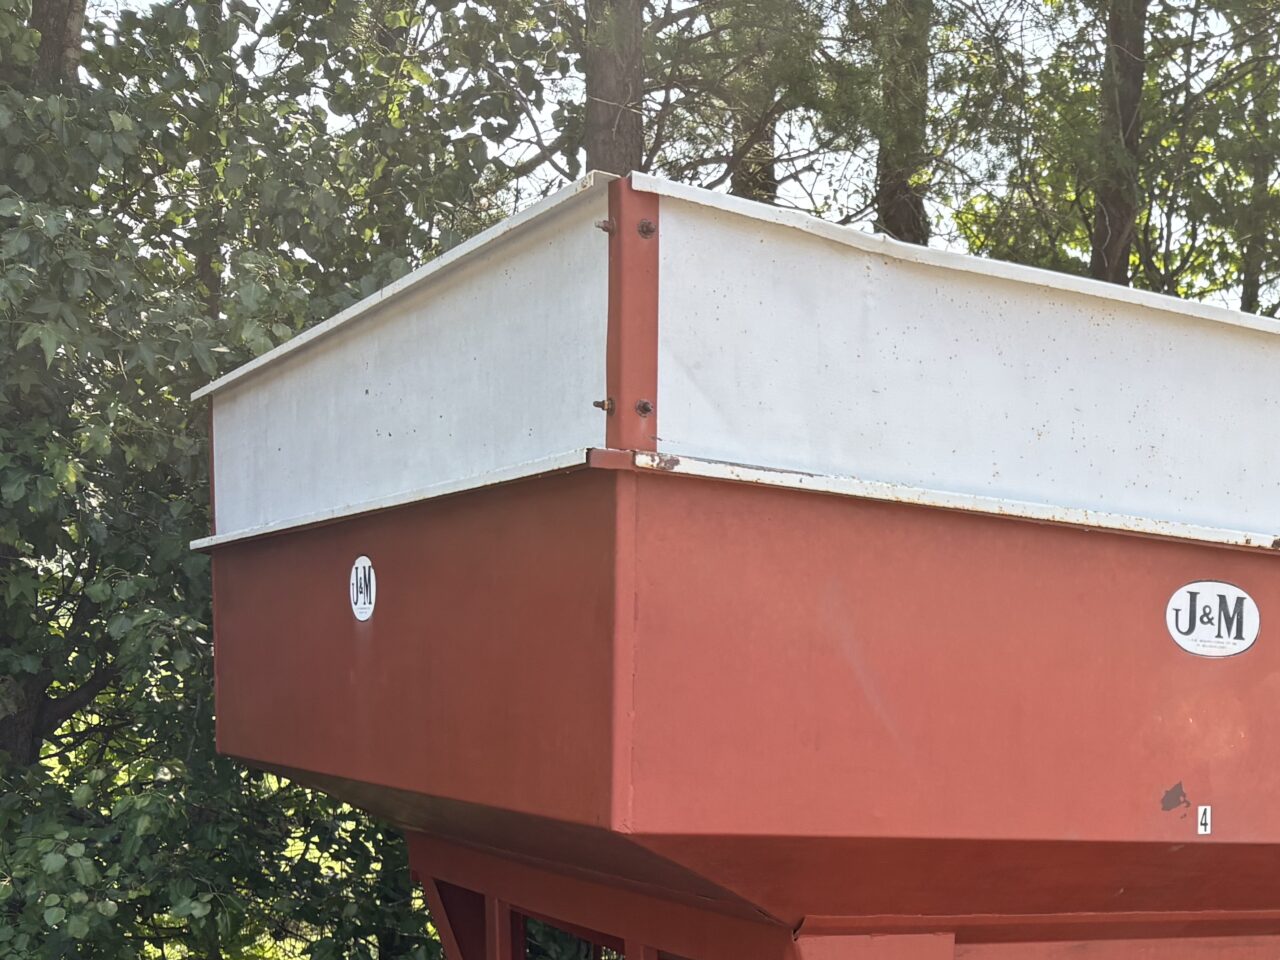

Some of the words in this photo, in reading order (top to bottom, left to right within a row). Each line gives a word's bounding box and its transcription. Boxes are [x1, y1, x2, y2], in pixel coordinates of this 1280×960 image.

[352, 566, 372, 606] J&M
[1172, 591, 1247, 641] J&M
[1200, 807, 1209, 832] 4
